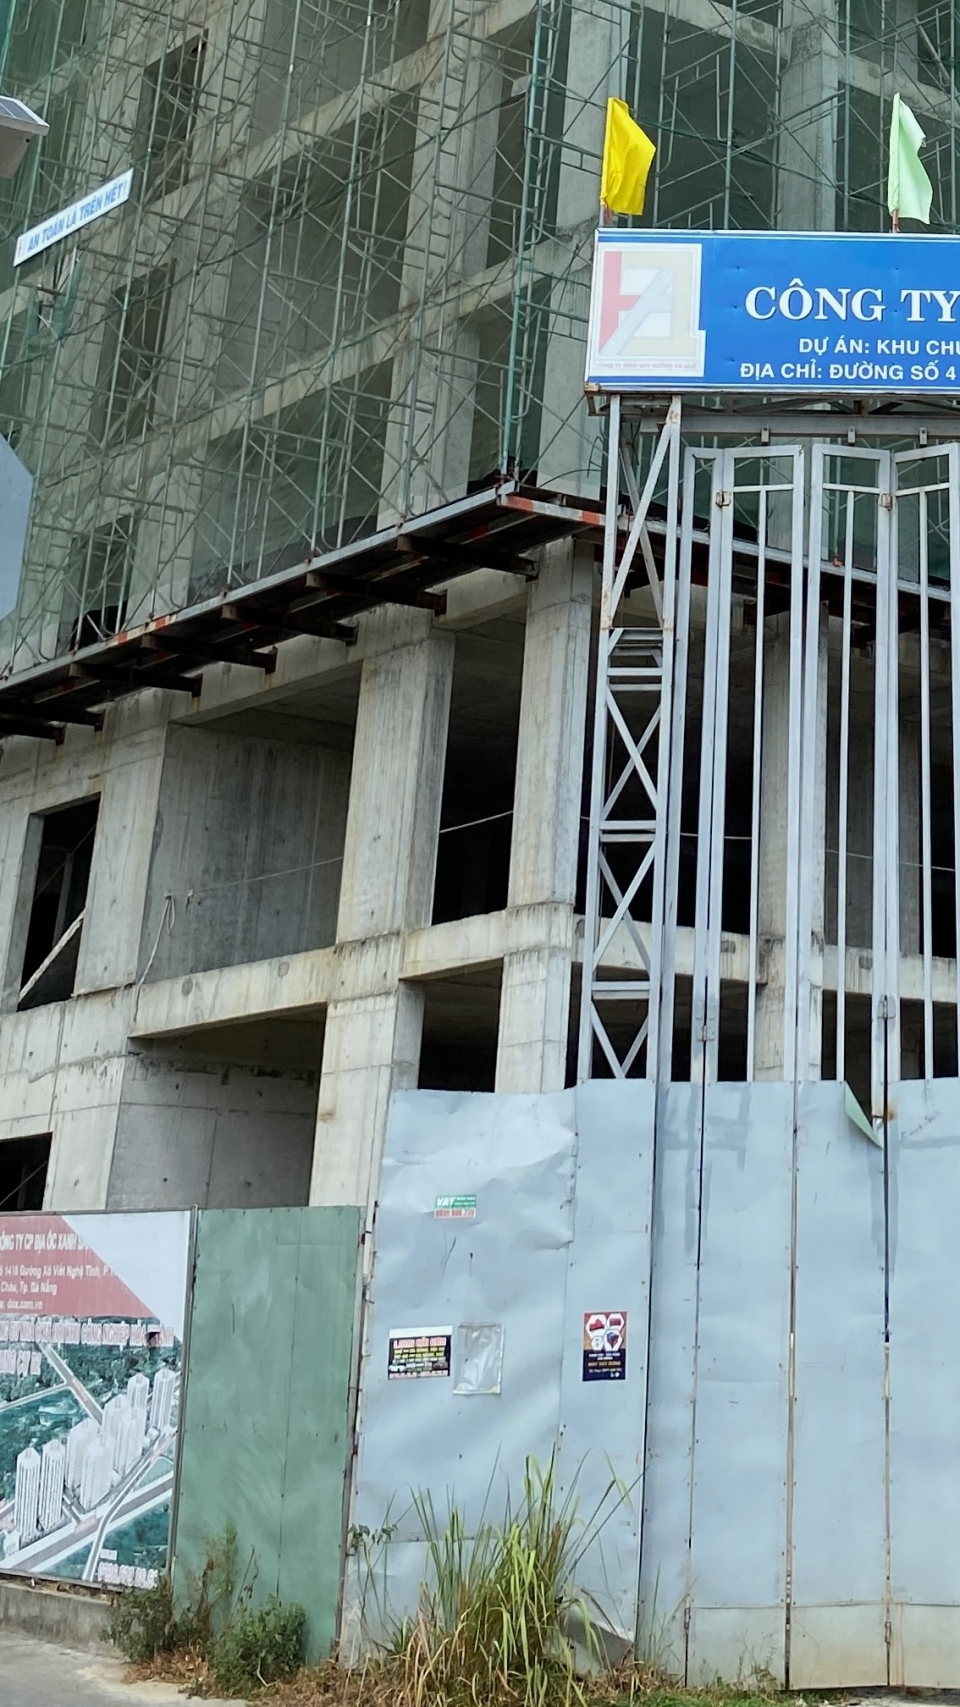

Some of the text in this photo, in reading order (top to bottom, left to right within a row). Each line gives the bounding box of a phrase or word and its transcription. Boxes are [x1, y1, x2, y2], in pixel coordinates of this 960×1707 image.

[28, 234, 40, 252] AN
[745, 277, 886, 322] CÔNG
[799, 336, 829, 356] DỰ
[833, 335, 870, 354] ÁN:
[877, 339, 920, 355] KHU
[739, 362, 775, 381] ĐỊA
[780, 358, 822, 379] CHỈ:
[828, 360, 904, 381] ĐƯỜNG
[910, 360, 940, 381] SỐ
[945, 366, 957, 381] 4
[436, 1196, 457, 1207] VAY
